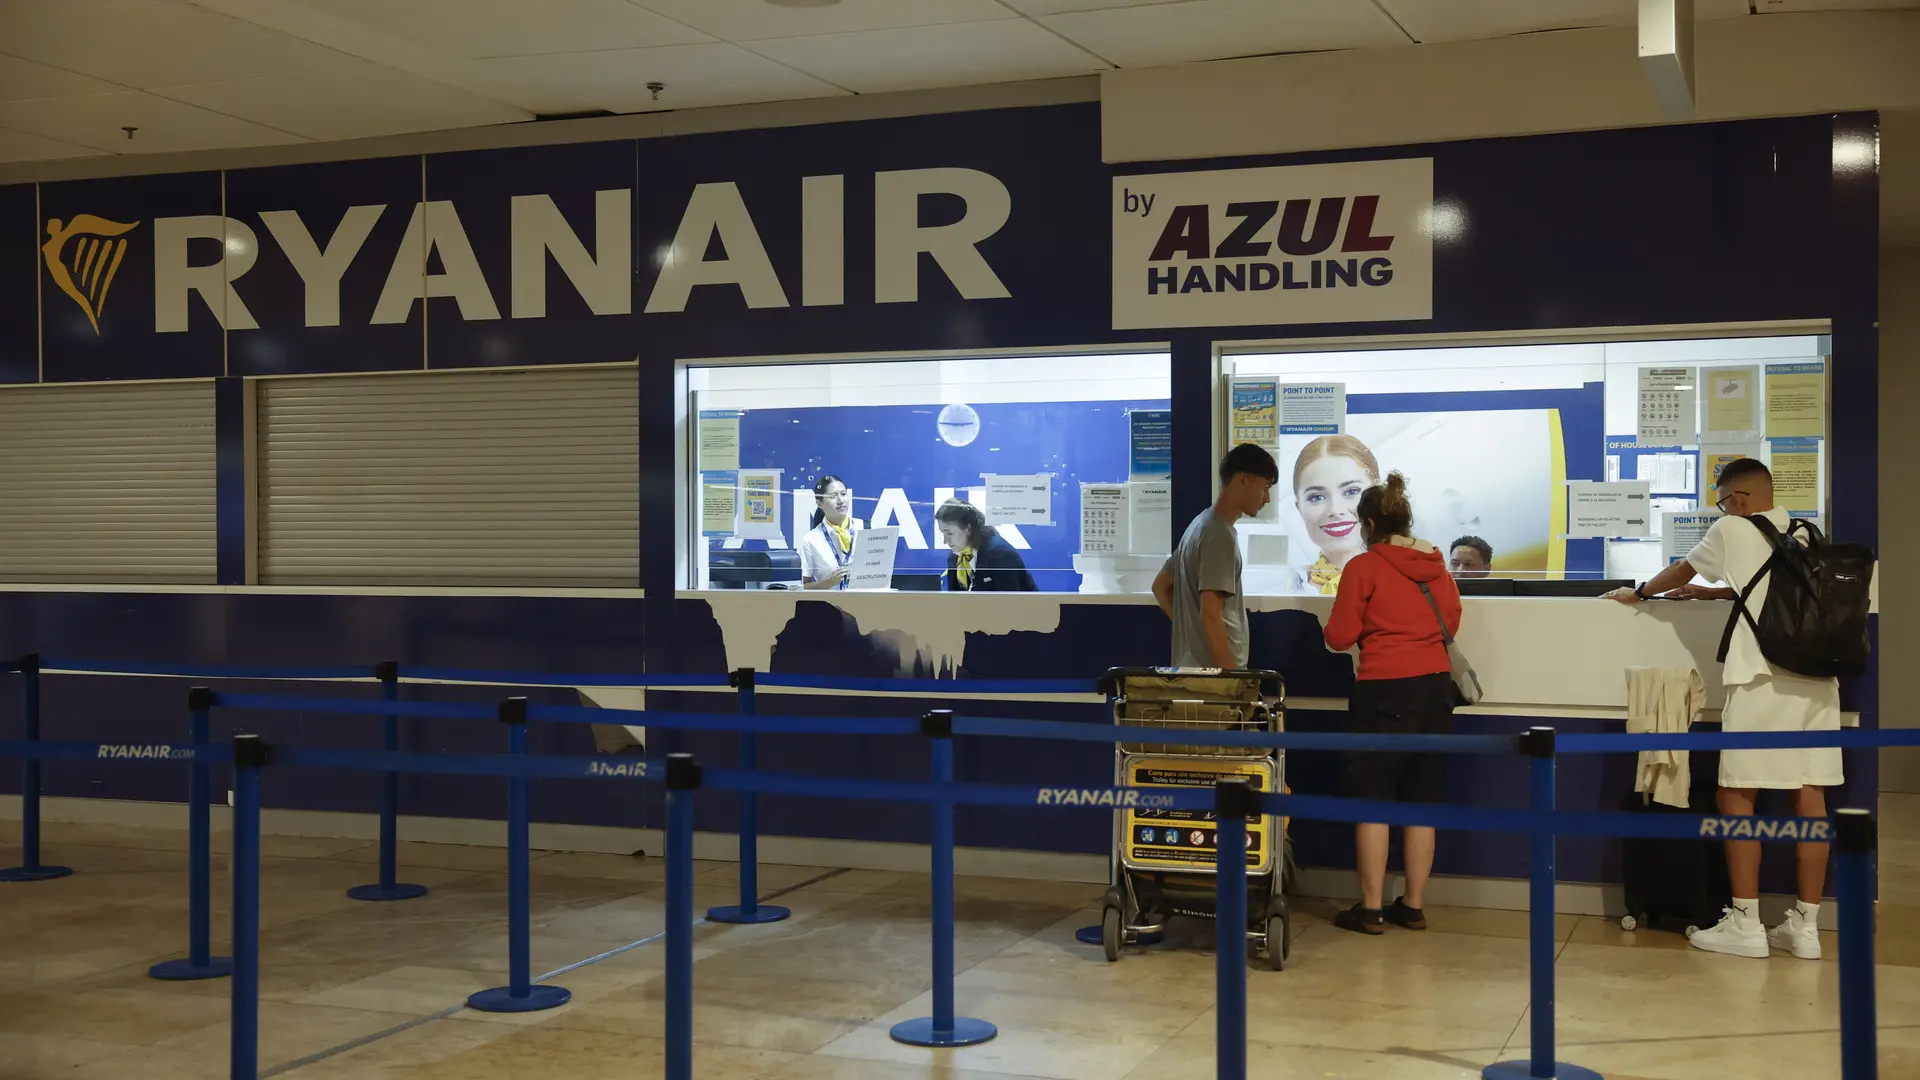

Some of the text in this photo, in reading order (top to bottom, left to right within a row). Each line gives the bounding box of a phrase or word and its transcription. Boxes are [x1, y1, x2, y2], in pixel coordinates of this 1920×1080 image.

[1124, 188, 1155, 217] by
[1148, 195, 1394, 261] AZUL
[154, 167, 1012, 333] RYANAIR
[1148, 257, 1393, 295] HANDLING
[98, 744, 195, 759] RYANAIR.COM
[1152, 777, 1169, 785] Trolley
[1037, 789, 1173, 806] RYANAIR.COM
[1699, 818, 1836, 839] RYANAIR.
